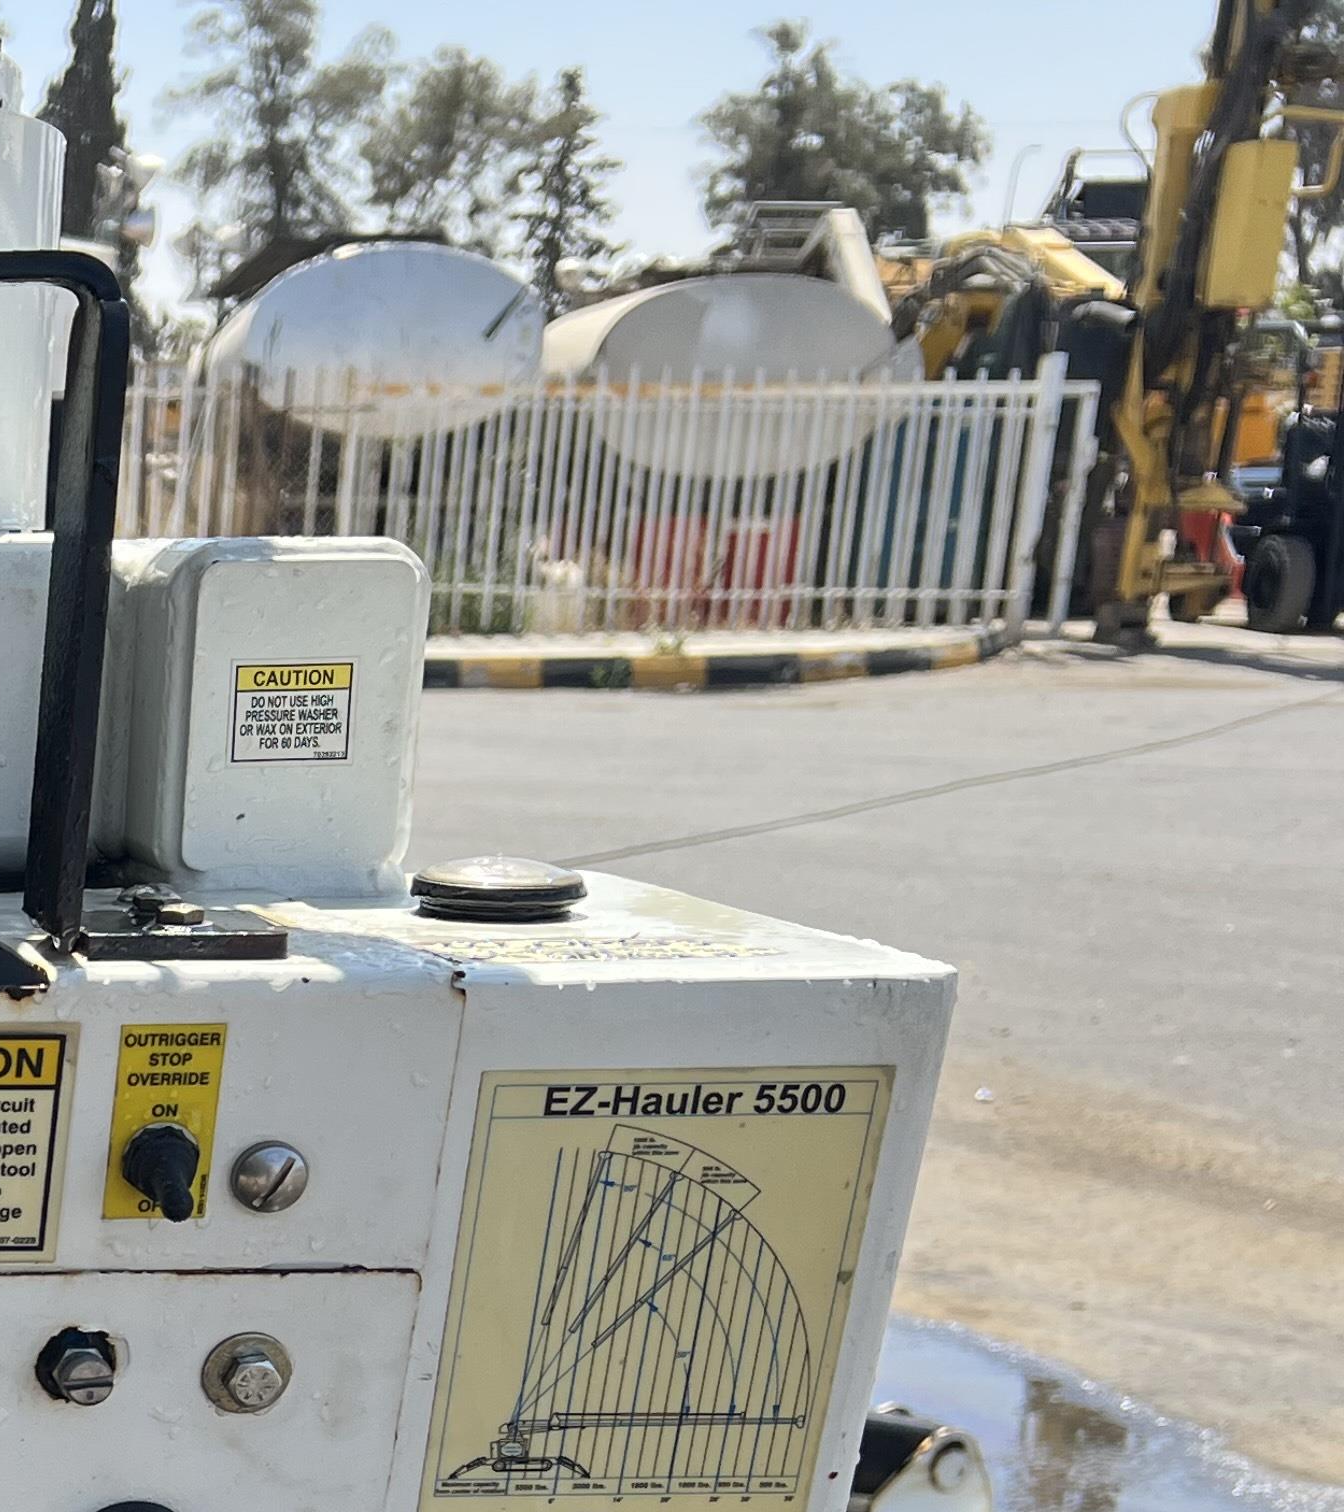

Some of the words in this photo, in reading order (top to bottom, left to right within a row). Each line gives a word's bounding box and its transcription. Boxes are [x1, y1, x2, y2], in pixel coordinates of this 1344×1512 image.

[253, 669, 334, 686] CAUTION
[251, 696, 265, 708] DO
[267, 695, 287, 708] NOT
[289, 695, 308, 707] USE
[310, 694, 333, 706] HIGH
[245, 709, 295, 722] PRESSURE
[298, 708, 337, 720] WASHER
[239, 724, 253, 736] OR
[255, 723, 277, 735] WAX
[279, 723, 293, 735] ON
[295, 721, 341, 734] EXTERIOR
[124, 1032, 220, 1047] OUTRIGGER
[148, 1052, 192, 1066] STOP
[127, 1071, 209, 1086] OVERRIDE
[543, 1085, 743, 1116] EZ-Hauler
[753, 1083, 846, 1114] 5500
[151, 1103, 178, 1117] ON
